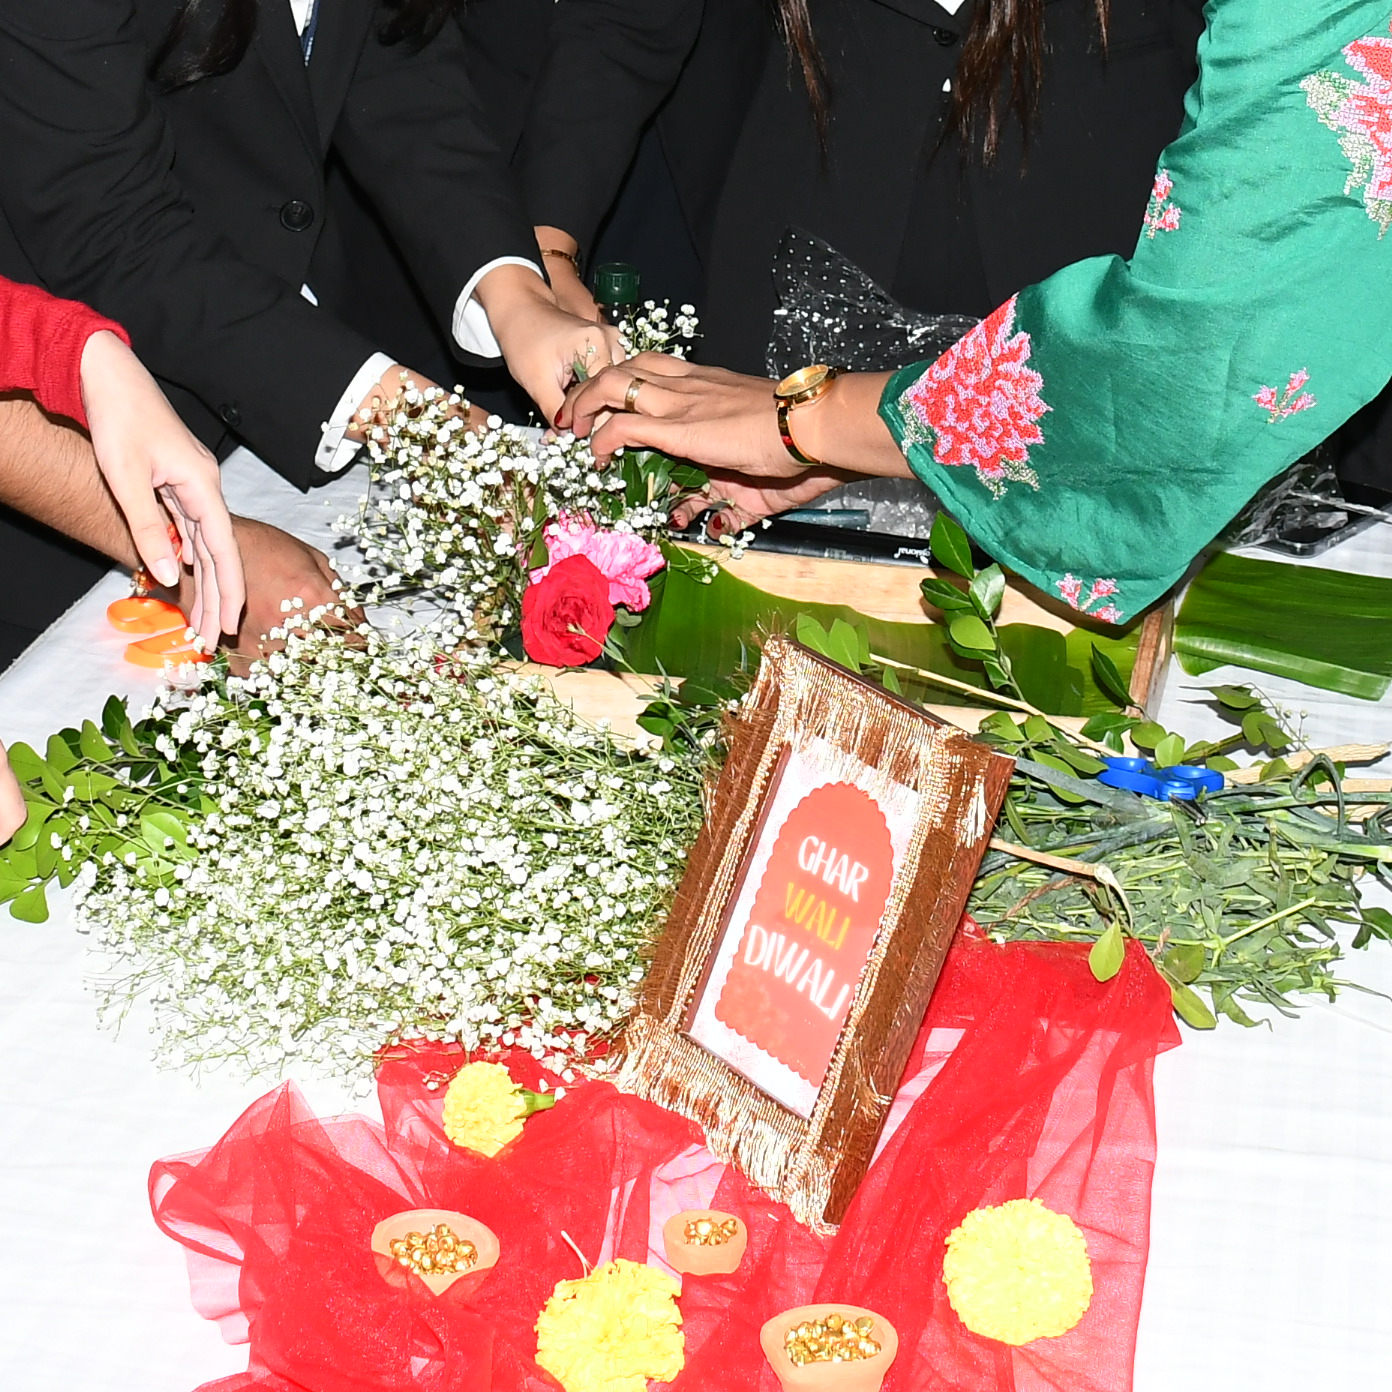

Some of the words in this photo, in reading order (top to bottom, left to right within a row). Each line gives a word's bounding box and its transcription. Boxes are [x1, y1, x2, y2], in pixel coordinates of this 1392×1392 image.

[798, 835, 869, 902] GHAR
[784, 881, 851, 951] WALI
[743, 924, 850, 1021] DIWALI
